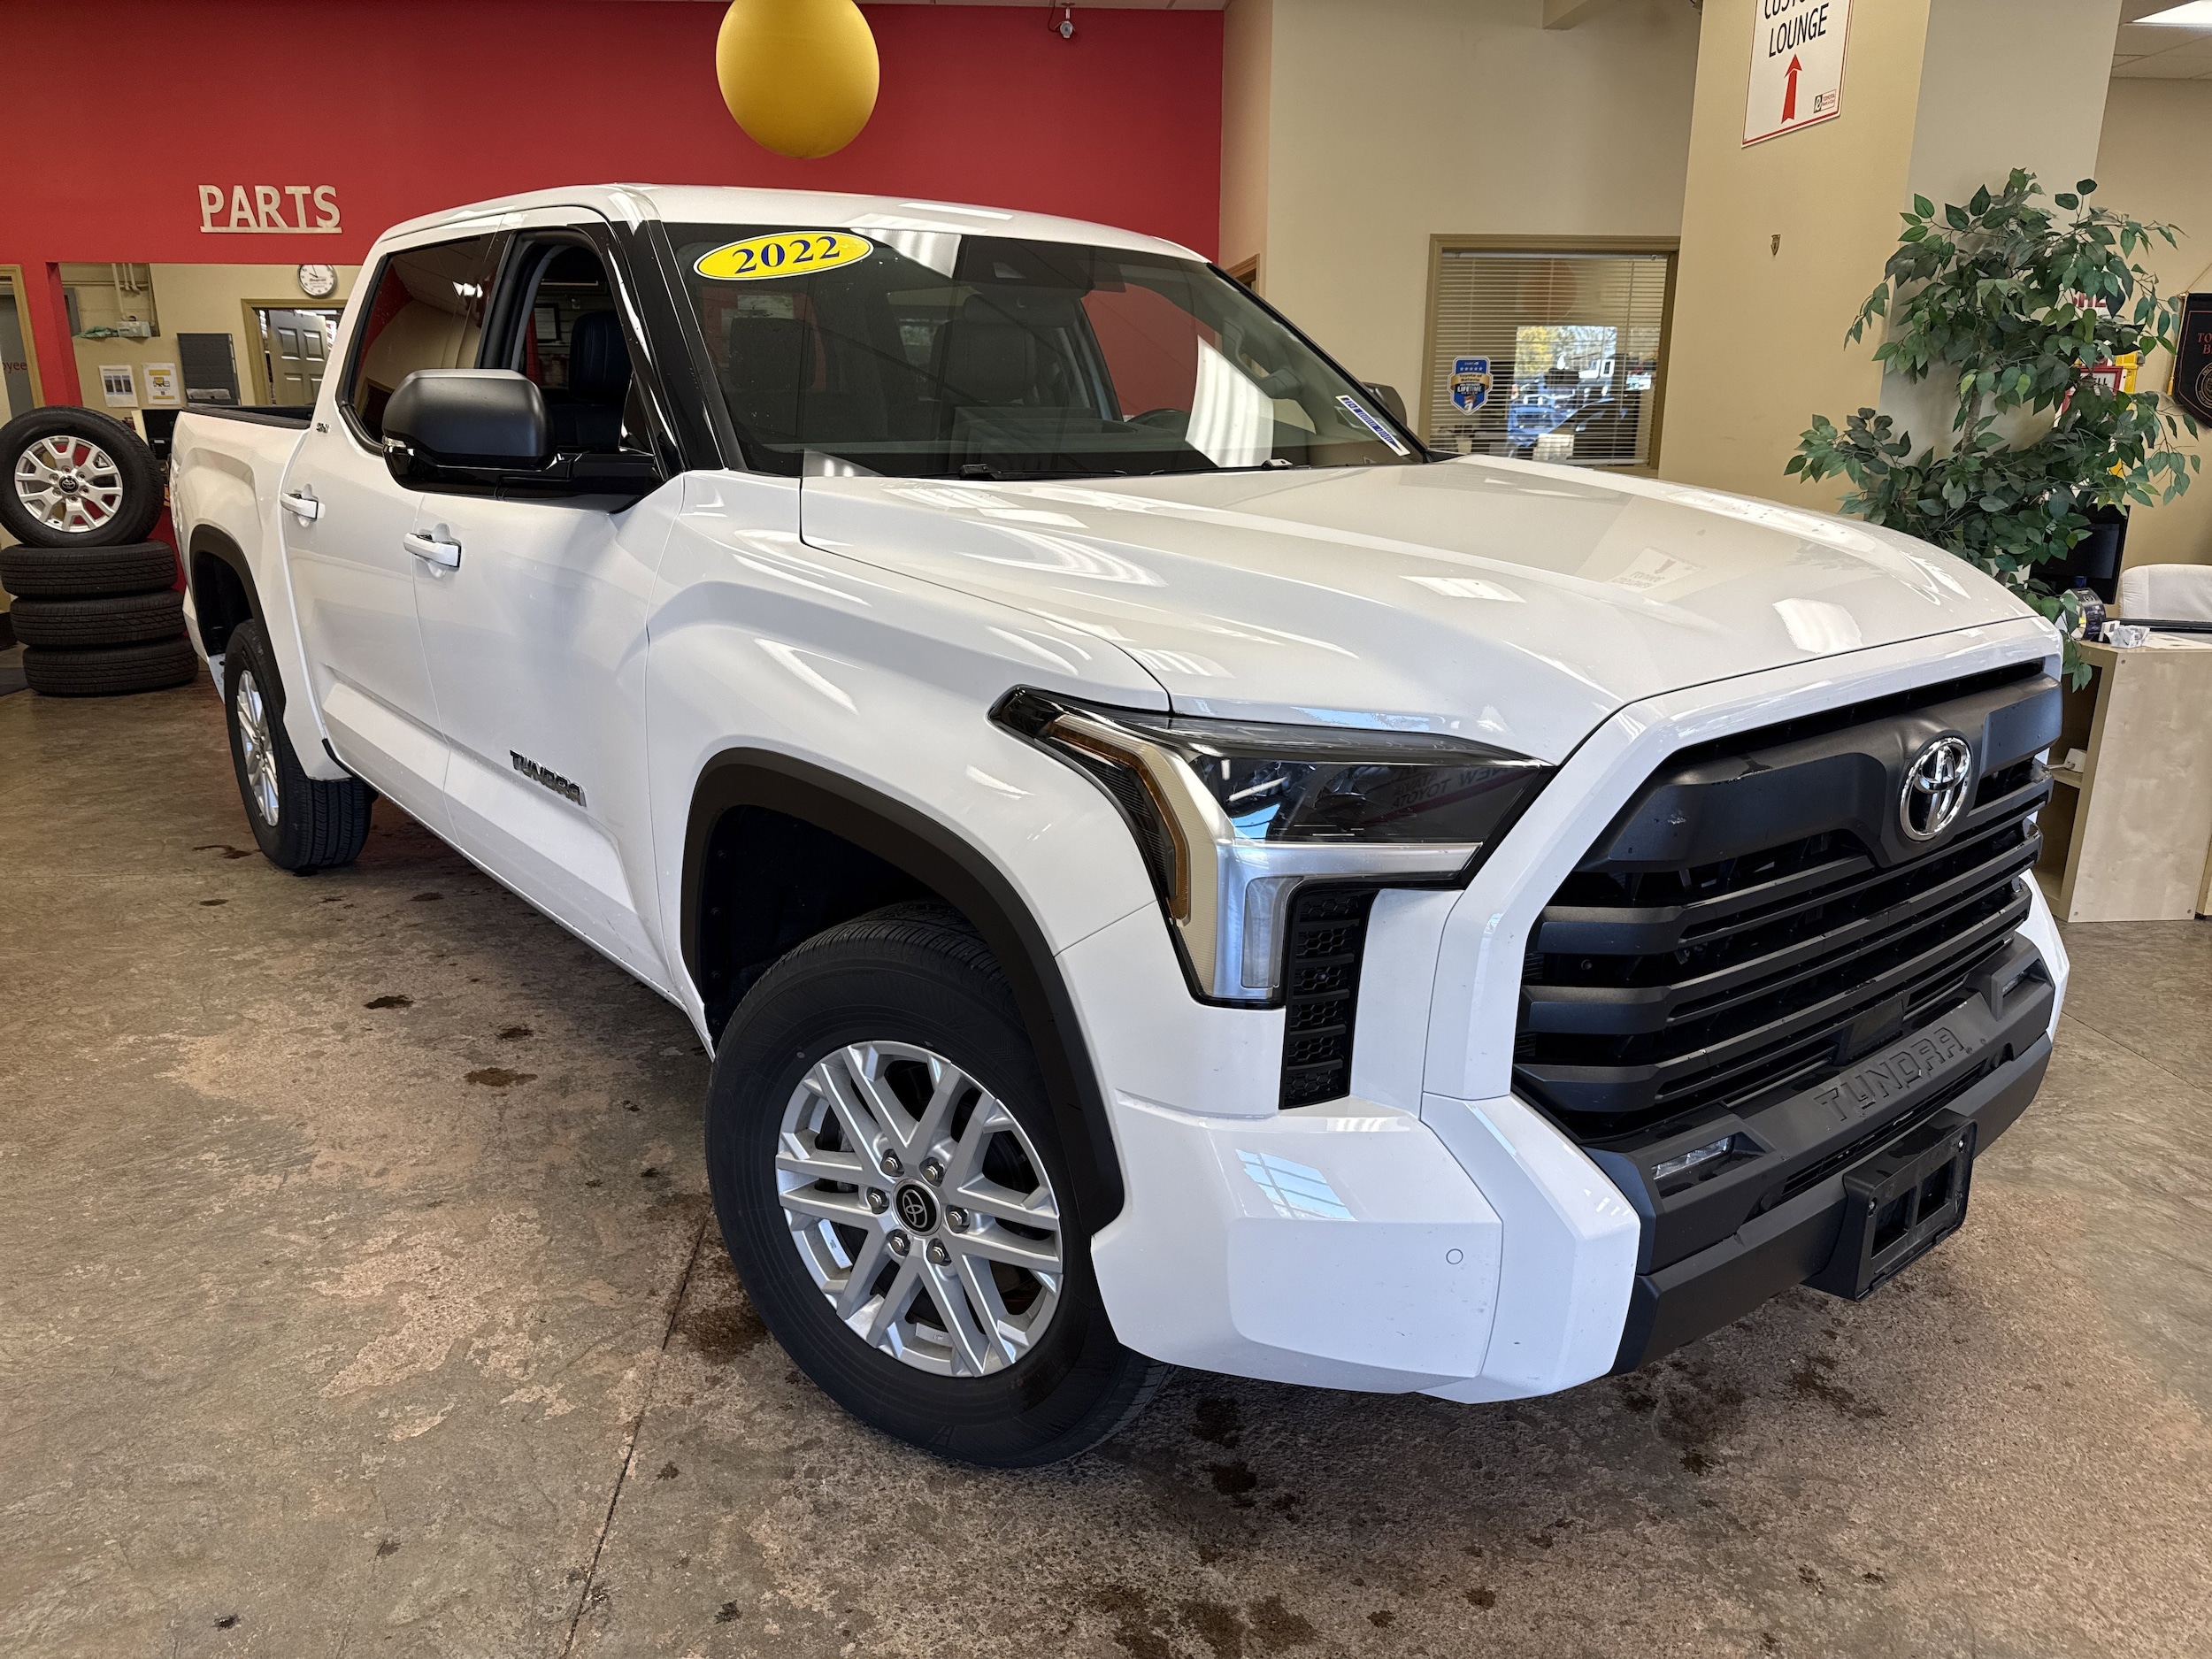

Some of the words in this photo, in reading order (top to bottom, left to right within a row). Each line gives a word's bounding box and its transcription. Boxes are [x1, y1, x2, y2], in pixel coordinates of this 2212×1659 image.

[1768, 3, 1829, 58] LOUNGE
[198, 184, 342, 231] PARTS
[732, 235, 841, 274] 2022
[510, 749, 588, 807] TUNDRA
[1814, 1026, 1965, 1121] TUNDRA
